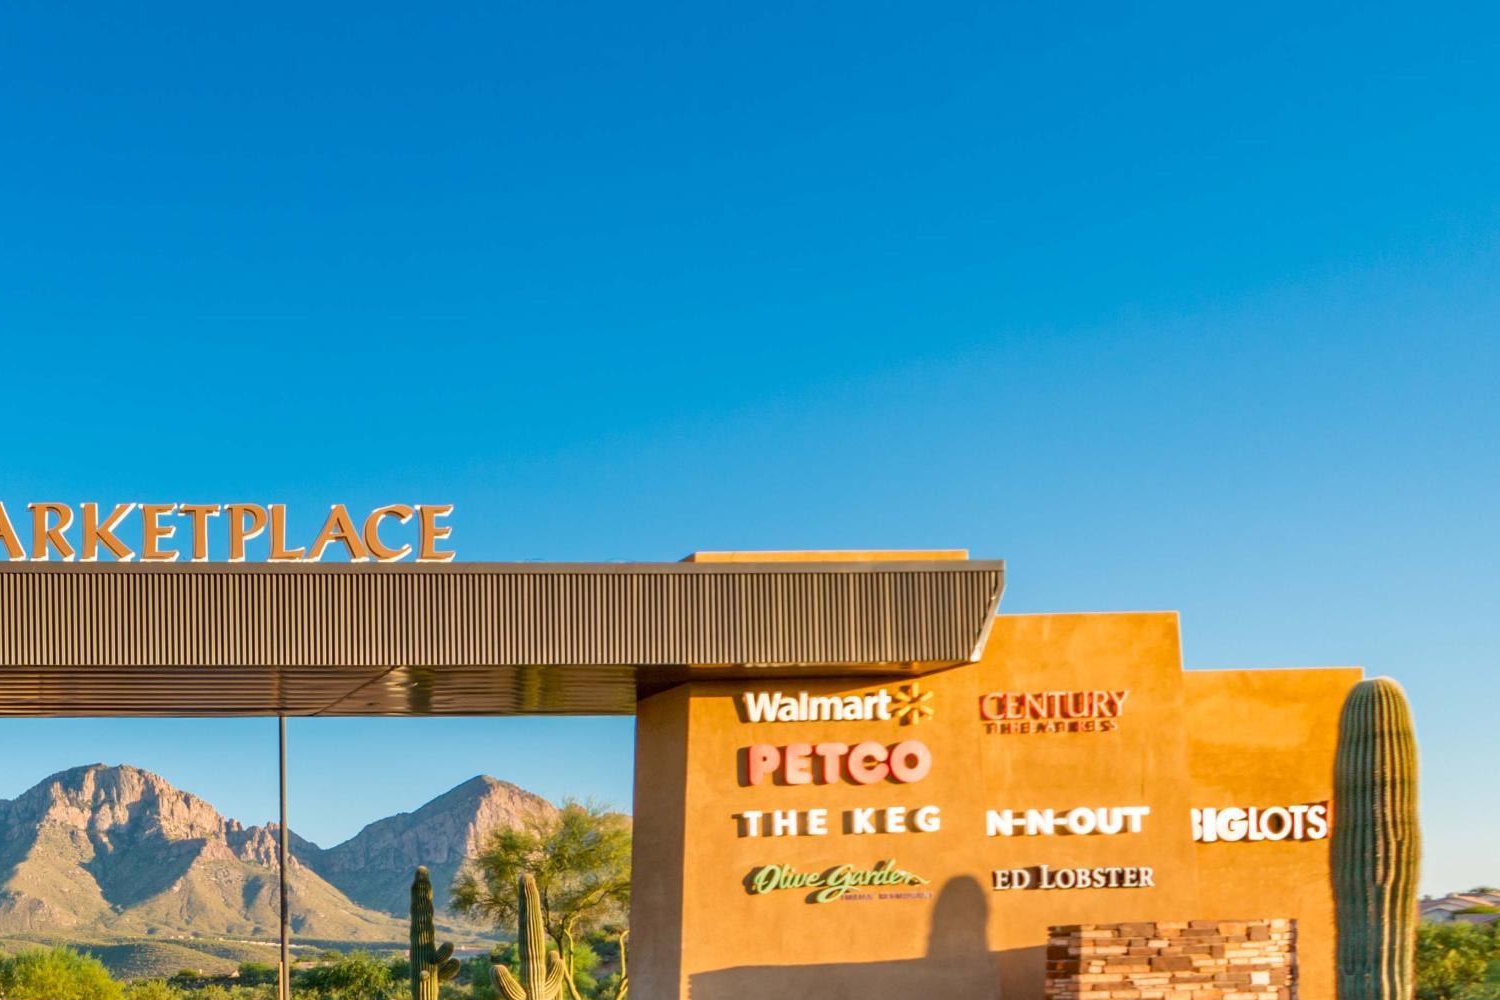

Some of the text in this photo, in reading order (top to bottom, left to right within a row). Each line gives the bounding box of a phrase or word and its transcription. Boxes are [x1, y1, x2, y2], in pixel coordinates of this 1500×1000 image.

[744, 689, 892, 722] Walmart
[981, 689, 1131, 720] CENTURY
[747, 739, 933, 785] PETCO
[743, 805, 941, 837] THE KEG
[751, 858, 931, 904] Olive Garden
[1040, 864, 1156, 889] LOBSTER
